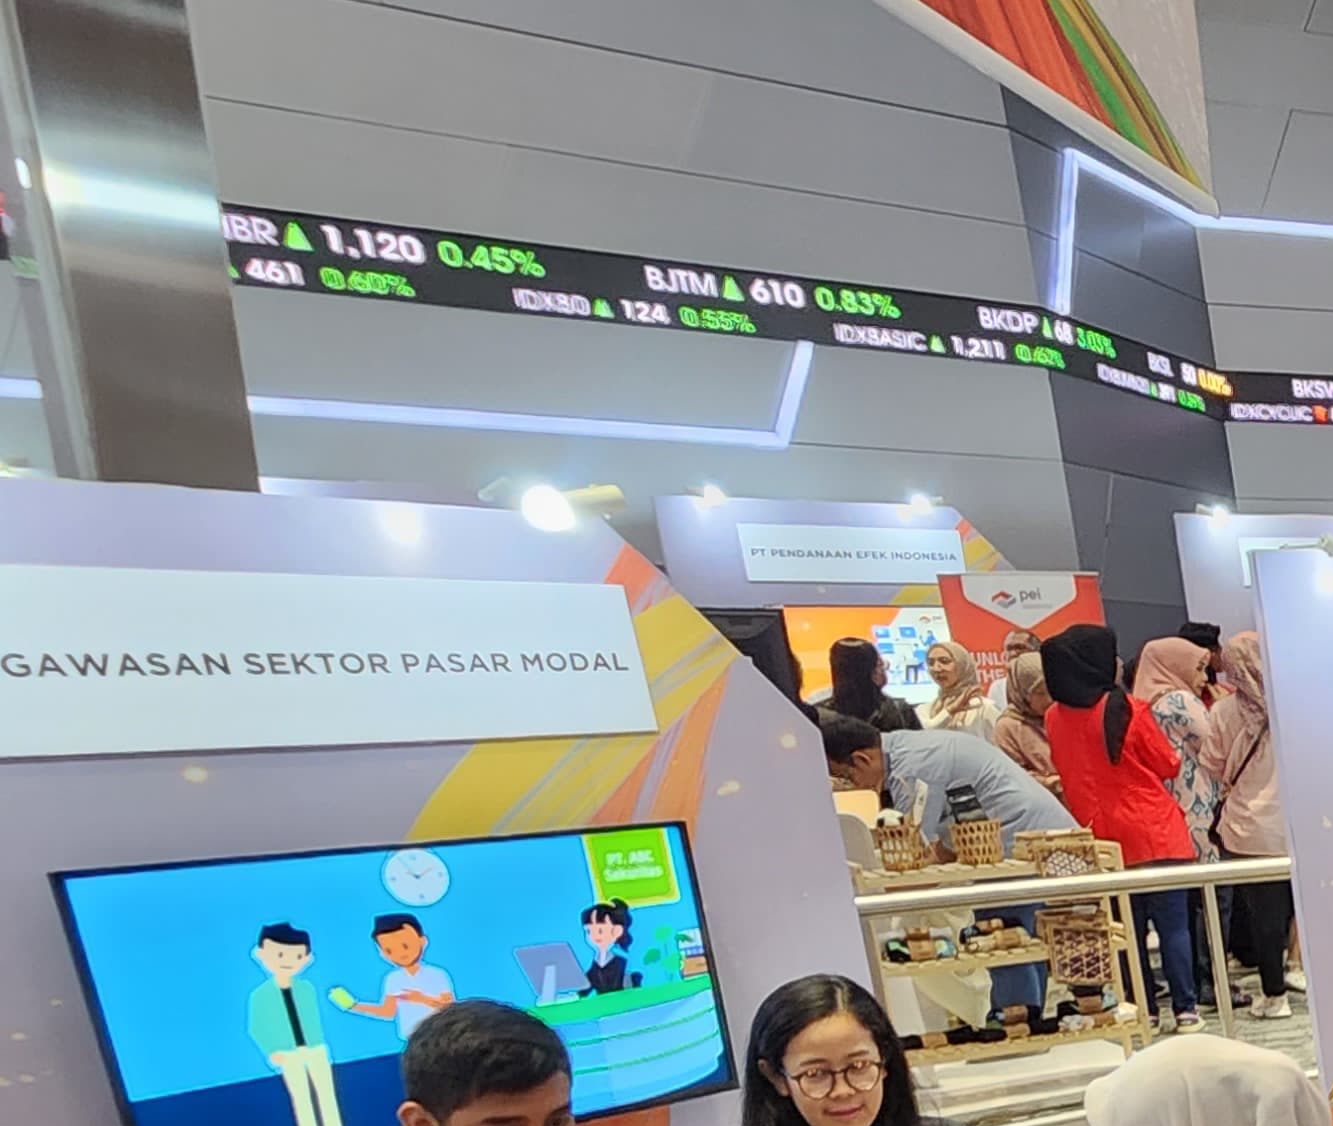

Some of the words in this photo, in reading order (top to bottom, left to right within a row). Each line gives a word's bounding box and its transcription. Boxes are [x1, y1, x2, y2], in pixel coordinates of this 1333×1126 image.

[245, 257, 305, 286] 461
[437, 240, 546, 278] 0.45%
[643, 264, 719, 298] BJTM
[750, 278, 806, 309] 610
[813, 285, 902, 320] 0.83%
[619, 298, 672, 325] 124
[976, 305, 1039, 335] BKDP
[750, 547, 767, 558] PT
[770, 548, 852, 560] PENDANAAN
[855, 550, 887, 560] EFEK
[890, 551, 957, 563] INDONESIA
[1019, 588, 1042, 602] pei
[0, 652, 231, 679] GAWASAN
[243, 652, 392, 676] SEKTOR
[402, 652, 513, 674] PASAR
[519, 651, 630, 673] MODAL
